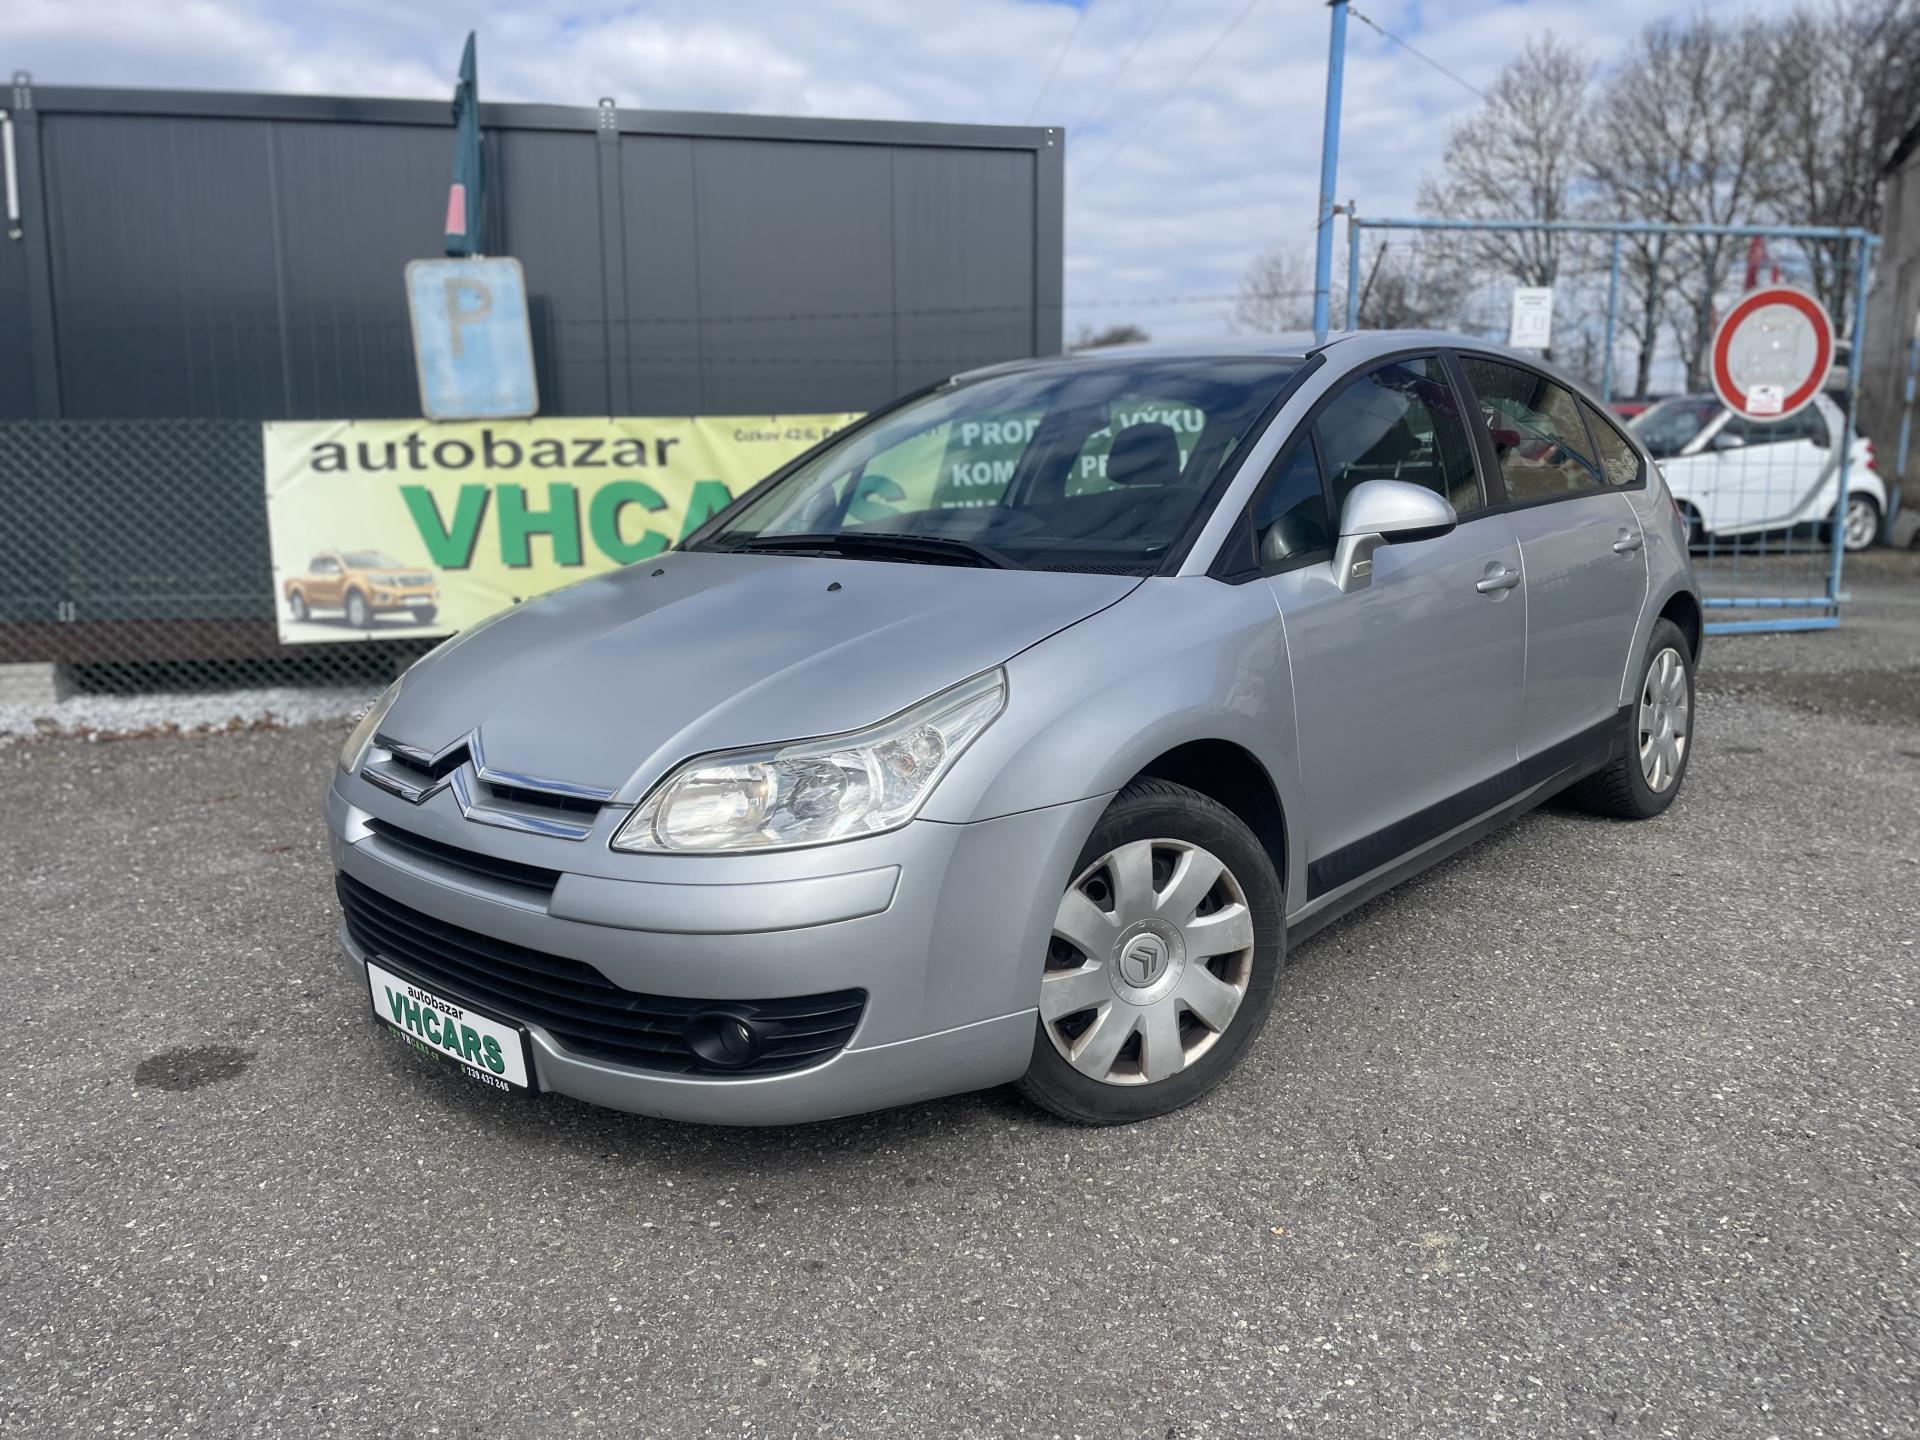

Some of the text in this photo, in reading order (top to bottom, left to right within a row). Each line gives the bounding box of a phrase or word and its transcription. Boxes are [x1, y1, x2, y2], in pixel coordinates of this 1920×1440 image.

[444, 276, 493, 358] P
[310, 430, 681, 473] autobazar
[385, 985, 505, 1075] VHCARS
[408, 987, 464, 1020] autobazar
